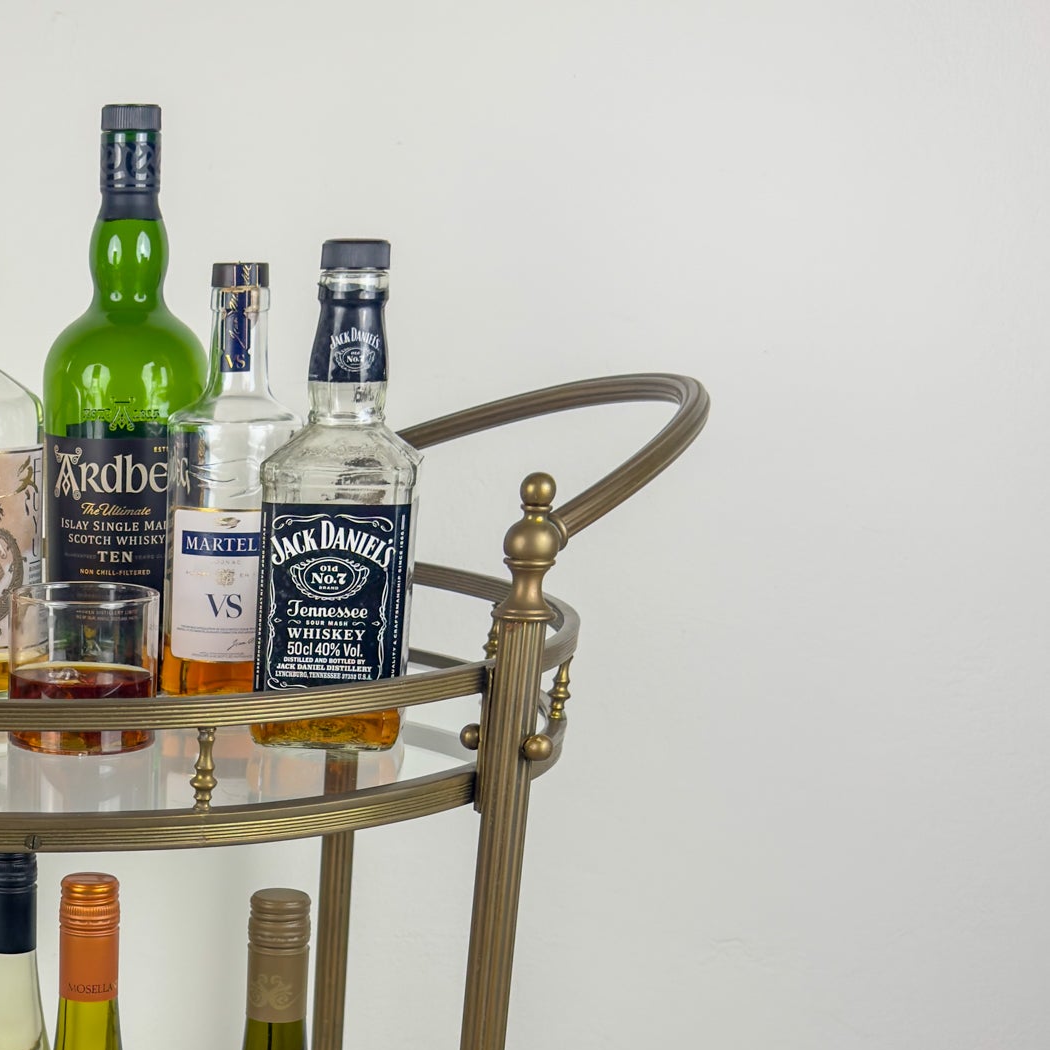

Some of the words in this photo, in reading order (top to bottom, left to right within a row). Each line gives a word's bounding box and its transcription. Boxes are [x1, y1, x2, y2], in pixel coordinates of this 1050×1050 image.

[330, 331, 350, 349] JACK
[351, 327, 380, 350] DANIEL'S
[81, 502, 99, 516] The
[98, 503, 152, 516] Ultimate
[61, 518, 90, 531] ISLAY
[93, 520, 140, 532] SINGLE
[144, 520, 167, 531] MA
[68, 533, 111, 545] SCOTCH
[116, 534, 166, 546] WHISKY
[186, 535, 259, 552] MARTEL
[270, 527, 319, 566] JACK
[320, 520, 396, 568] DANIEL'S
[97, 550, 133, 563] TEN
[311, 572, 347, 585] No.7
[205, 593, 243, 619] VS
[286, 600, 368, 619] Tennessee
[287, 627, 366, 641] WHISKEY
[287, 641, 313, 656] 50cl
[315, 642, 341, 657] 40%
[345, 643, 363, 658] Vol.
[297, 663, 325, 671] DANIEL
